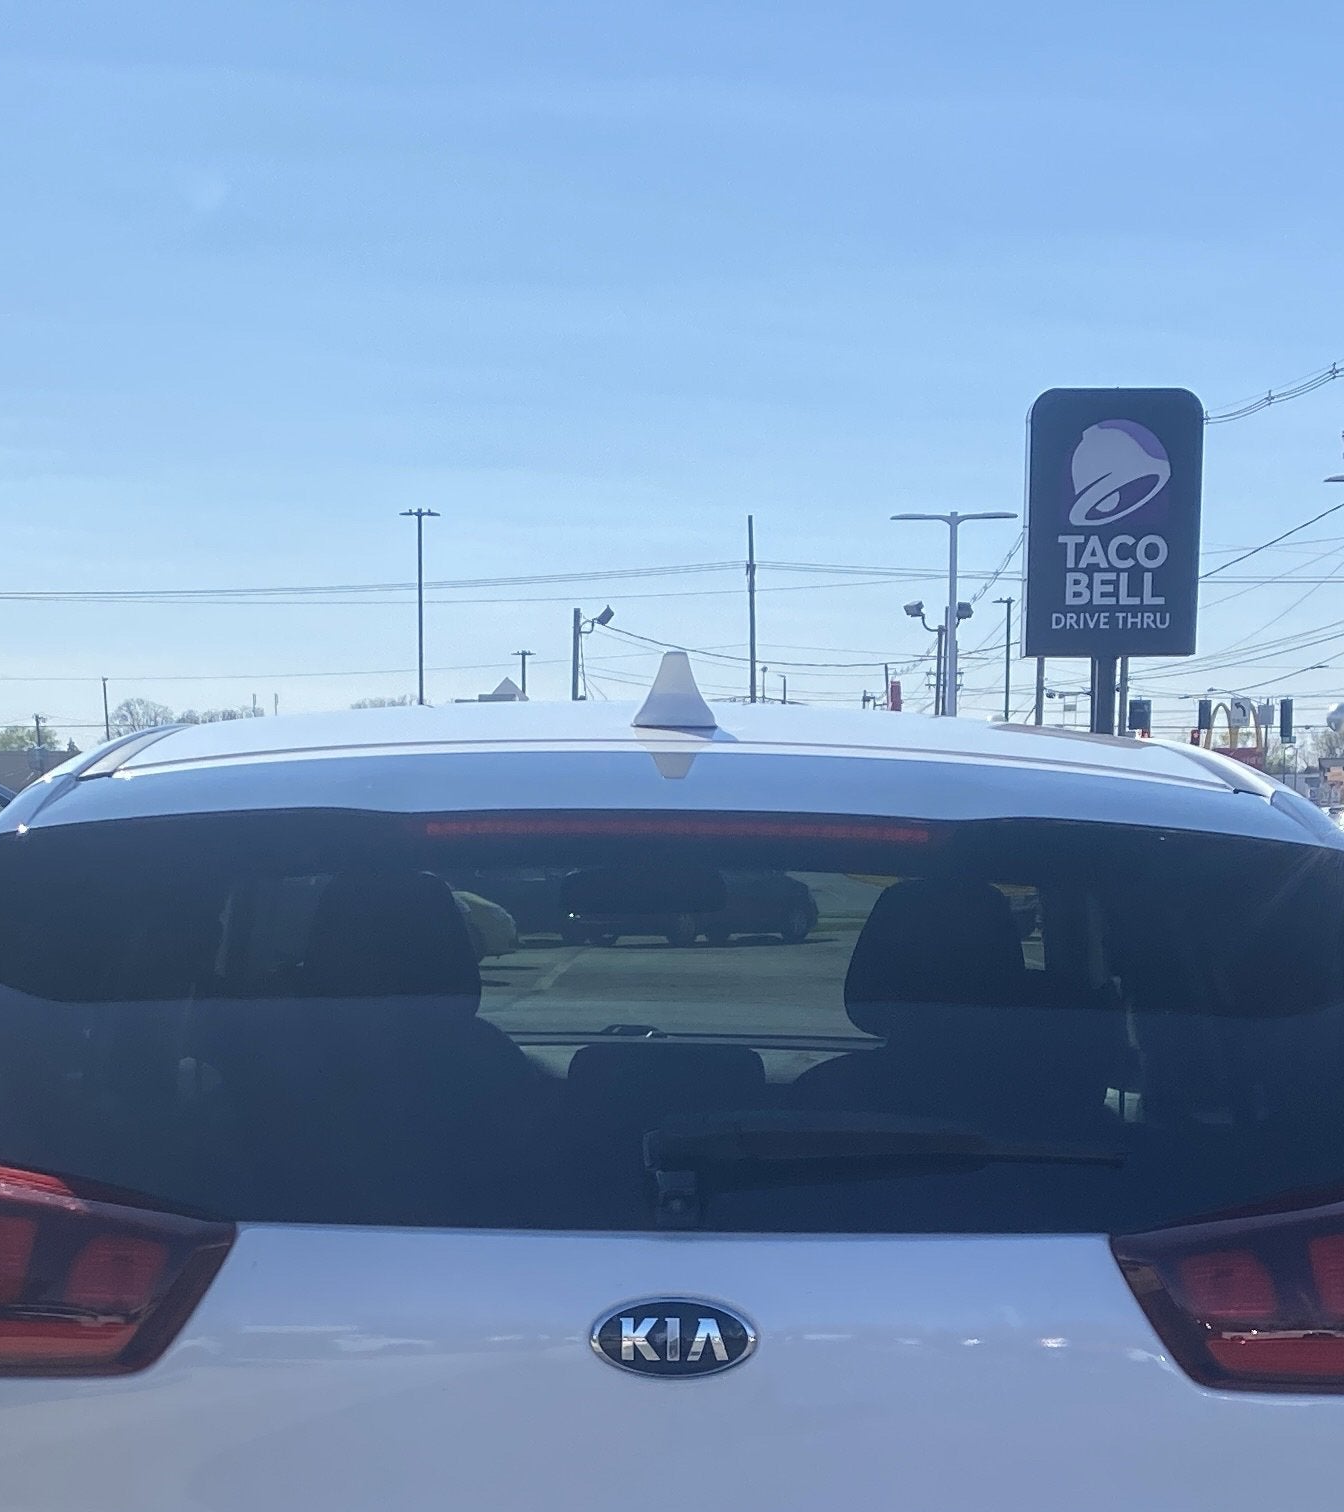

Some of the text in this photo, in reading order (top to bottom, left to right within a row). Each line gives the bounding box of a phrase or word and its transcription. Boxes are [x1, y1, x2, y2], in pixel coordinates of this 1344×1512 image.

[1058, 534, 1168, 569] TACO
[1065, 572, 1165, 605] BELL
[1051, 612, 1170, 629] DRIVE THRU
[620, 1317, 728, 1361] KIA
